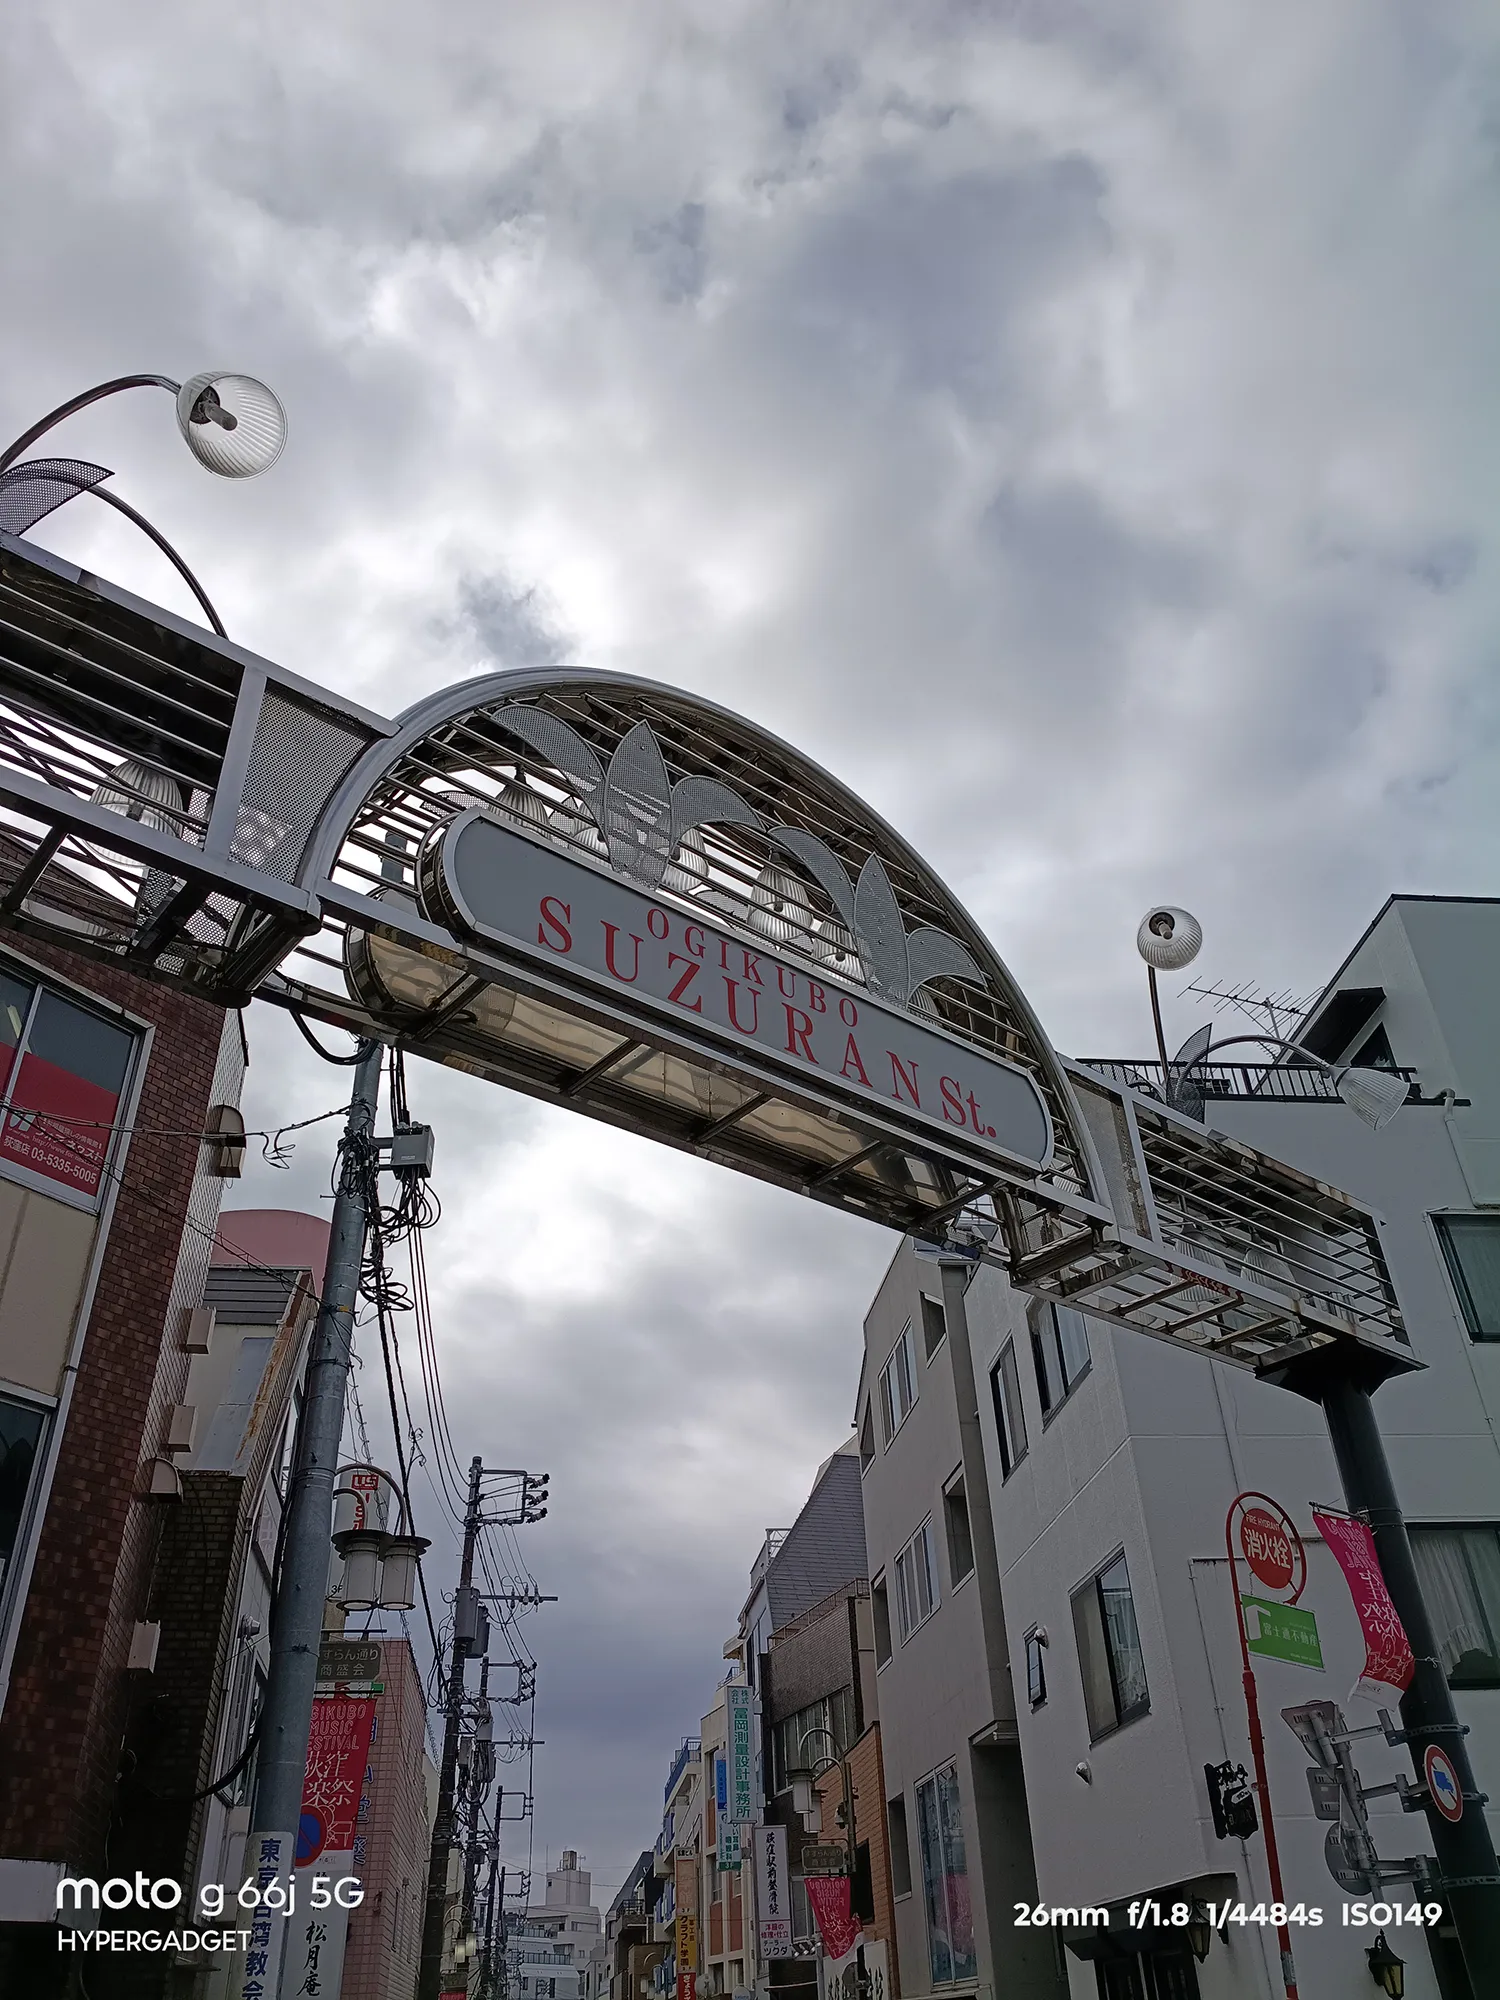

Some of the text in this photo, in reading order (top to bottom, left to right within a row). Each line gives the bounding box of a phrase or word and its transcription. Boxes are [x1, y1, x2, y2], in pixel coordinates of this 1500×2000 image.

[647, 907, 859, 1029] OGIKUBO
[538, 896, 998, 1139] SUZURAN St.
[31, 1146, 97, 1185] 03-5335-5005
[1245, 1513, 1280, 1532] FIRE HYDRANT
[1243, 1526, 1291, 1569] 消火栓
[309, 1719, 354, 1735] MUSIC
[310, 1703, 367, 1721] GIKUBO
[305, 1778, 355, 1806] 楽祭
[296, 1920, 327, 1997] 松月庵
